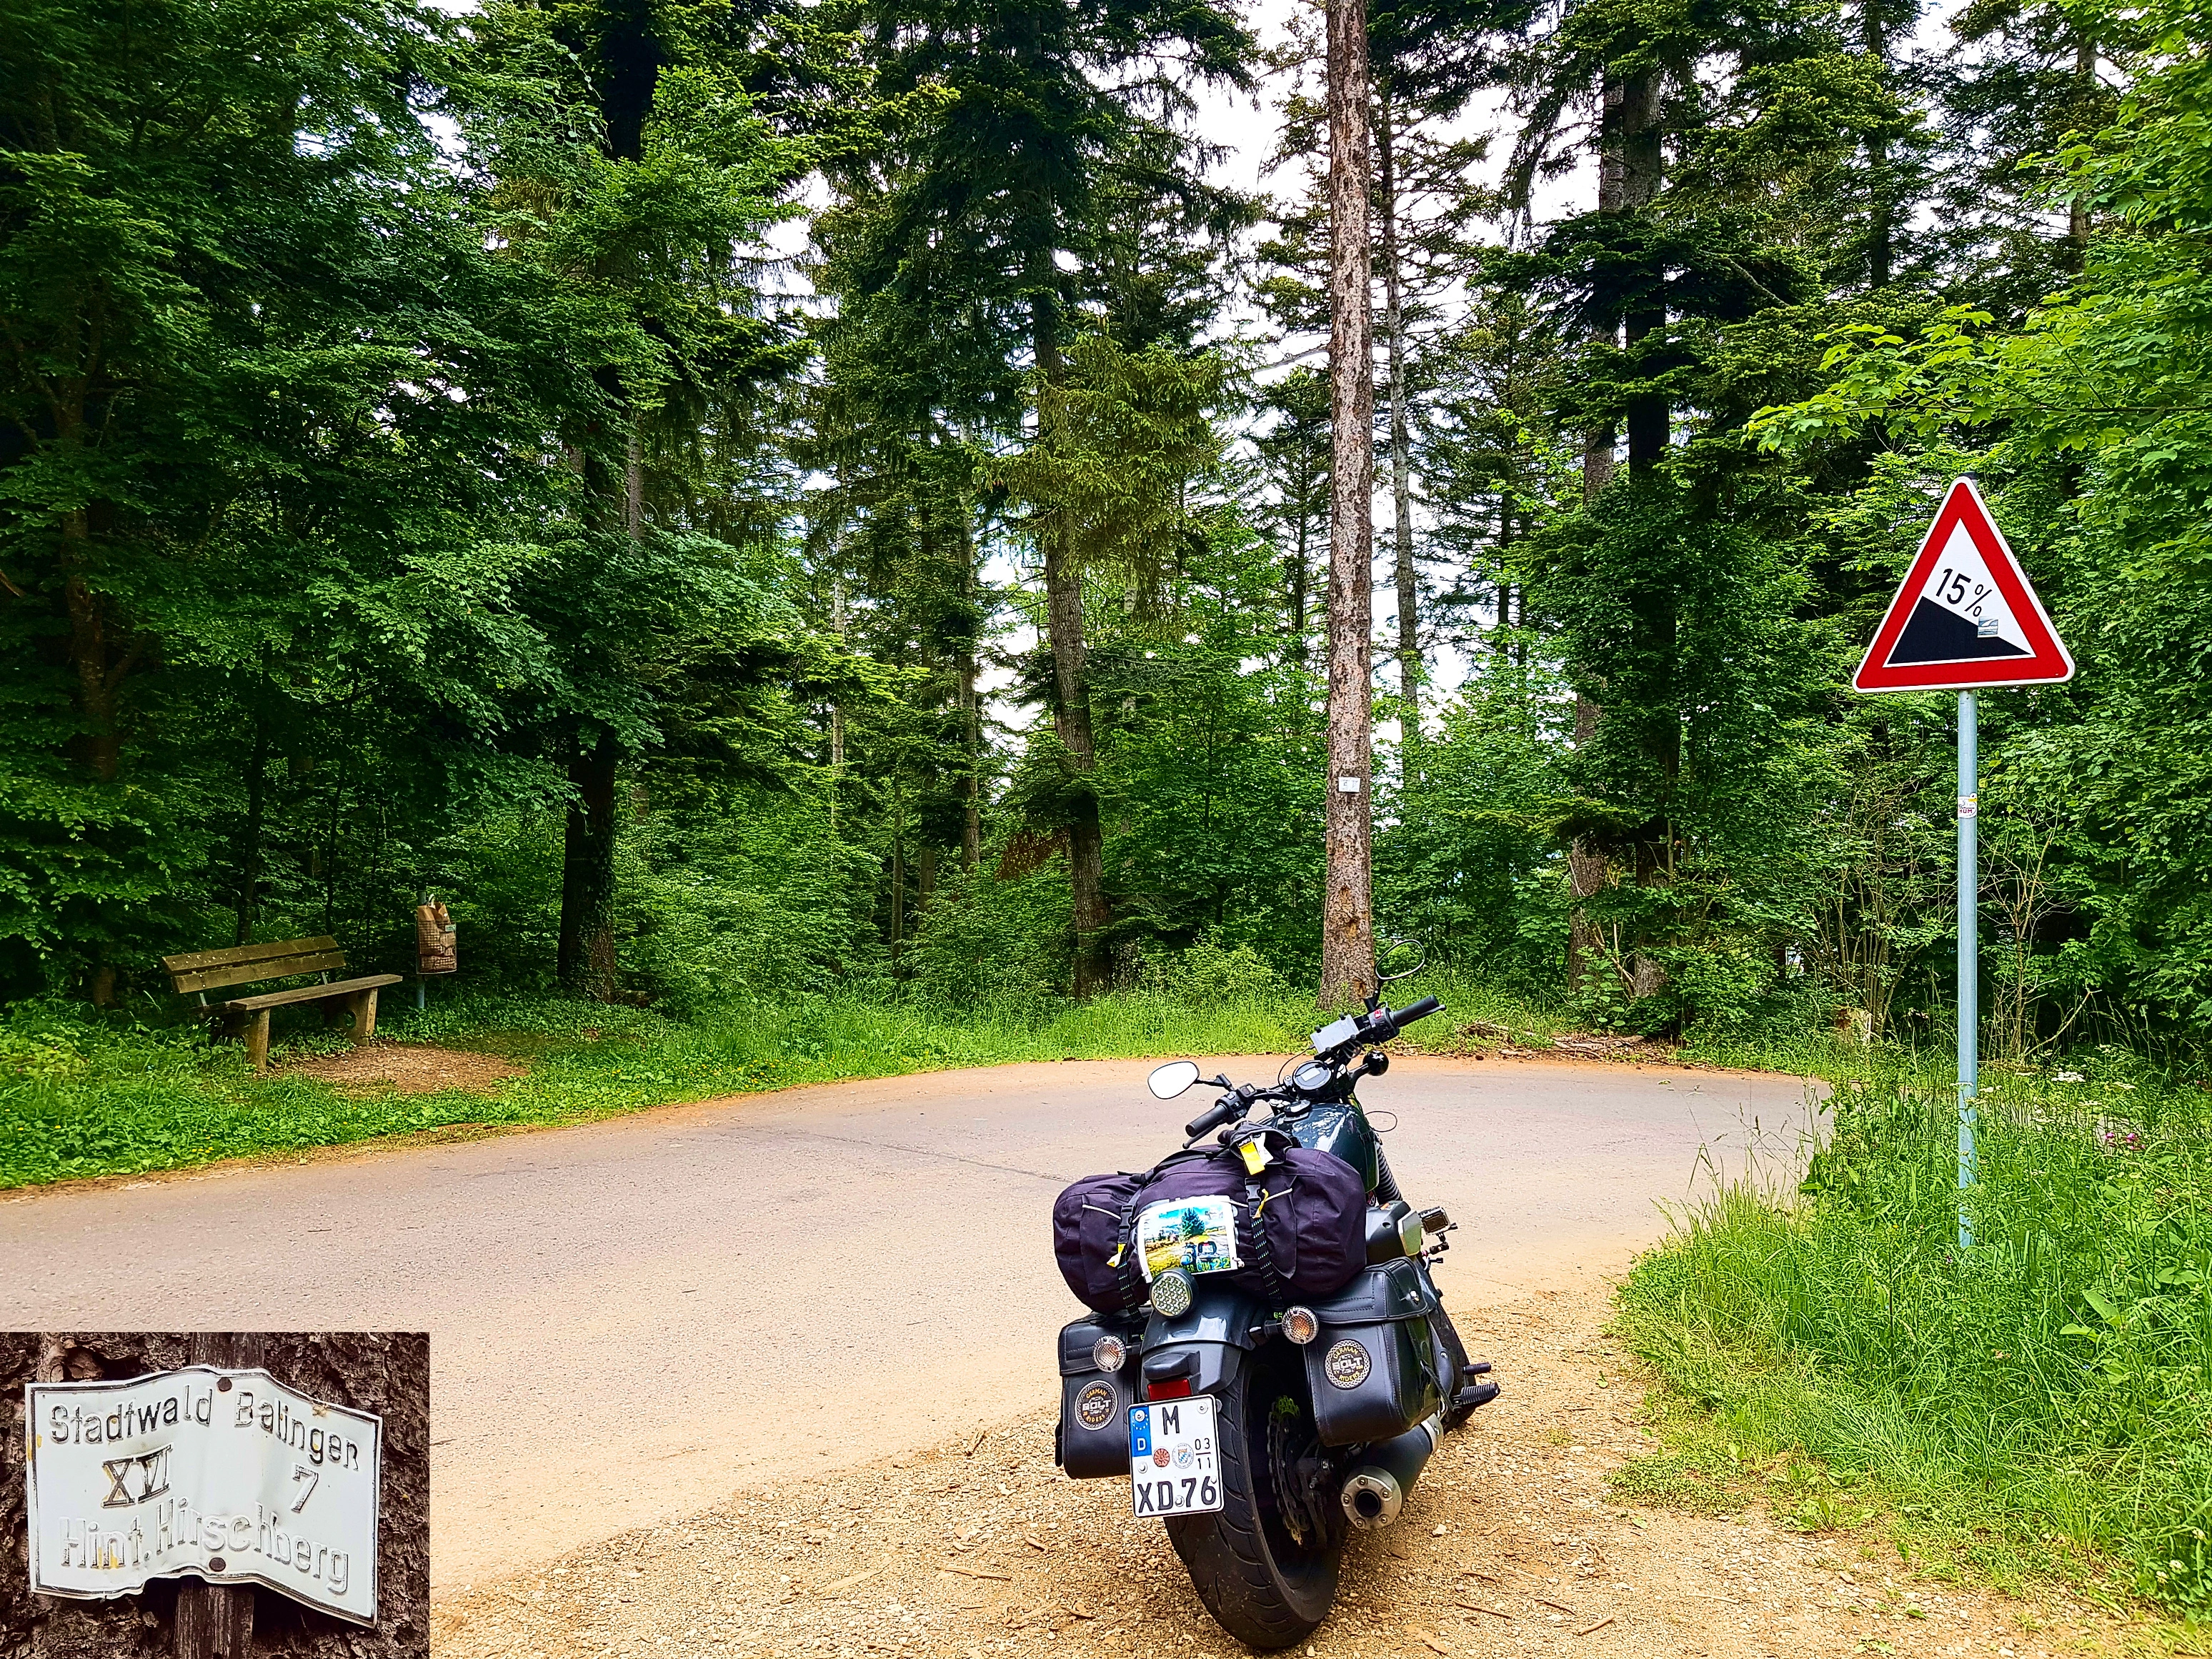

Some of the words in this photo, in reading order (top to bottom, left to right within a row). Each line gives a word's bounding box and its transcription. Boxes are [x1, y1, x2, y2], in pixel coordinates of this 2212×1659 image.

[1936, 568, 1992, 617] 15%
[1333, 1346, 1359, 1360] GERMAN
[1332, 1357, 1362, 1370] BOLT
[1338, 1370, 1360, 1382] RIDERS
[1082, 1399, 1112, 1411] BOLT
[1162, 1405, 1180, 1435] M
[50, 1385, 213, 1445] Stadtwald
[234, 1390, 360, 1472] Balinger
[1137, 1438, 1146, 1451] D
[1195, 1438, 1210, 1450] 03
[1197, 1457, 1211, 1470] 11
[101, 1443, 174, 1509] XVI
[292, 1463, 319, 1514] 7
[1137, 1480, 1174, 1513] XD
[1181, 1475, 1217, 1508] 76
[59, 1515, 152, 1569] Hint.
[156, 1497, 350, 1595] Hirschberg
